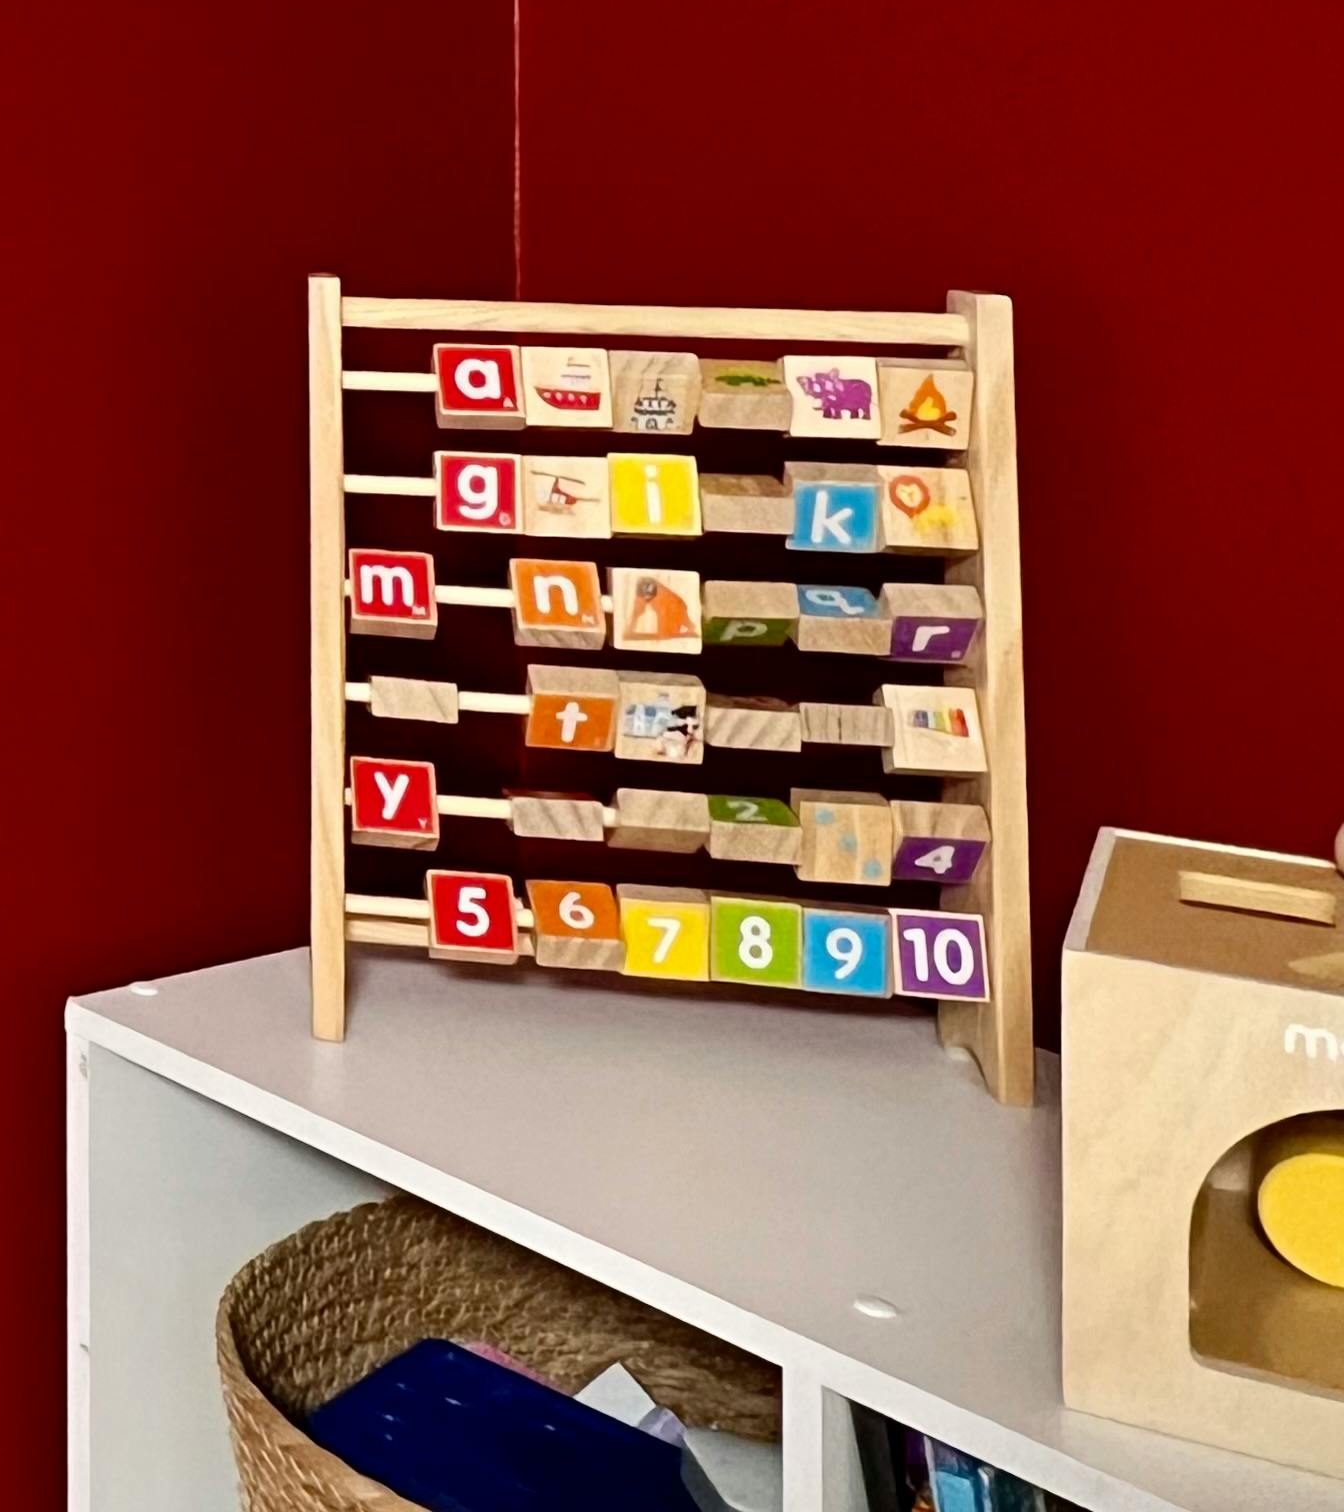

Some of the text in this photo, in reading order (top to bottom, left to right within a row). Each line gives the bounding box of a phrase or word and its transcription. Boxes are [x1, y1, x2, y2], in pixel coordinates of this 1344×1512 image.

[454, 358, 502, 400] a
[457, 463, 855, 545] g i k
[359, 564, 414, 608] m
[533, 575, 579, 616] n
[555, 701, 589, 743] t
[727, 799, 768, 823] 2
[914, 844, 956, 874] 4
[456, 886, 975, 986] 5 6 7 8 9 10
[1284, 1023, 1344, 1063] m
